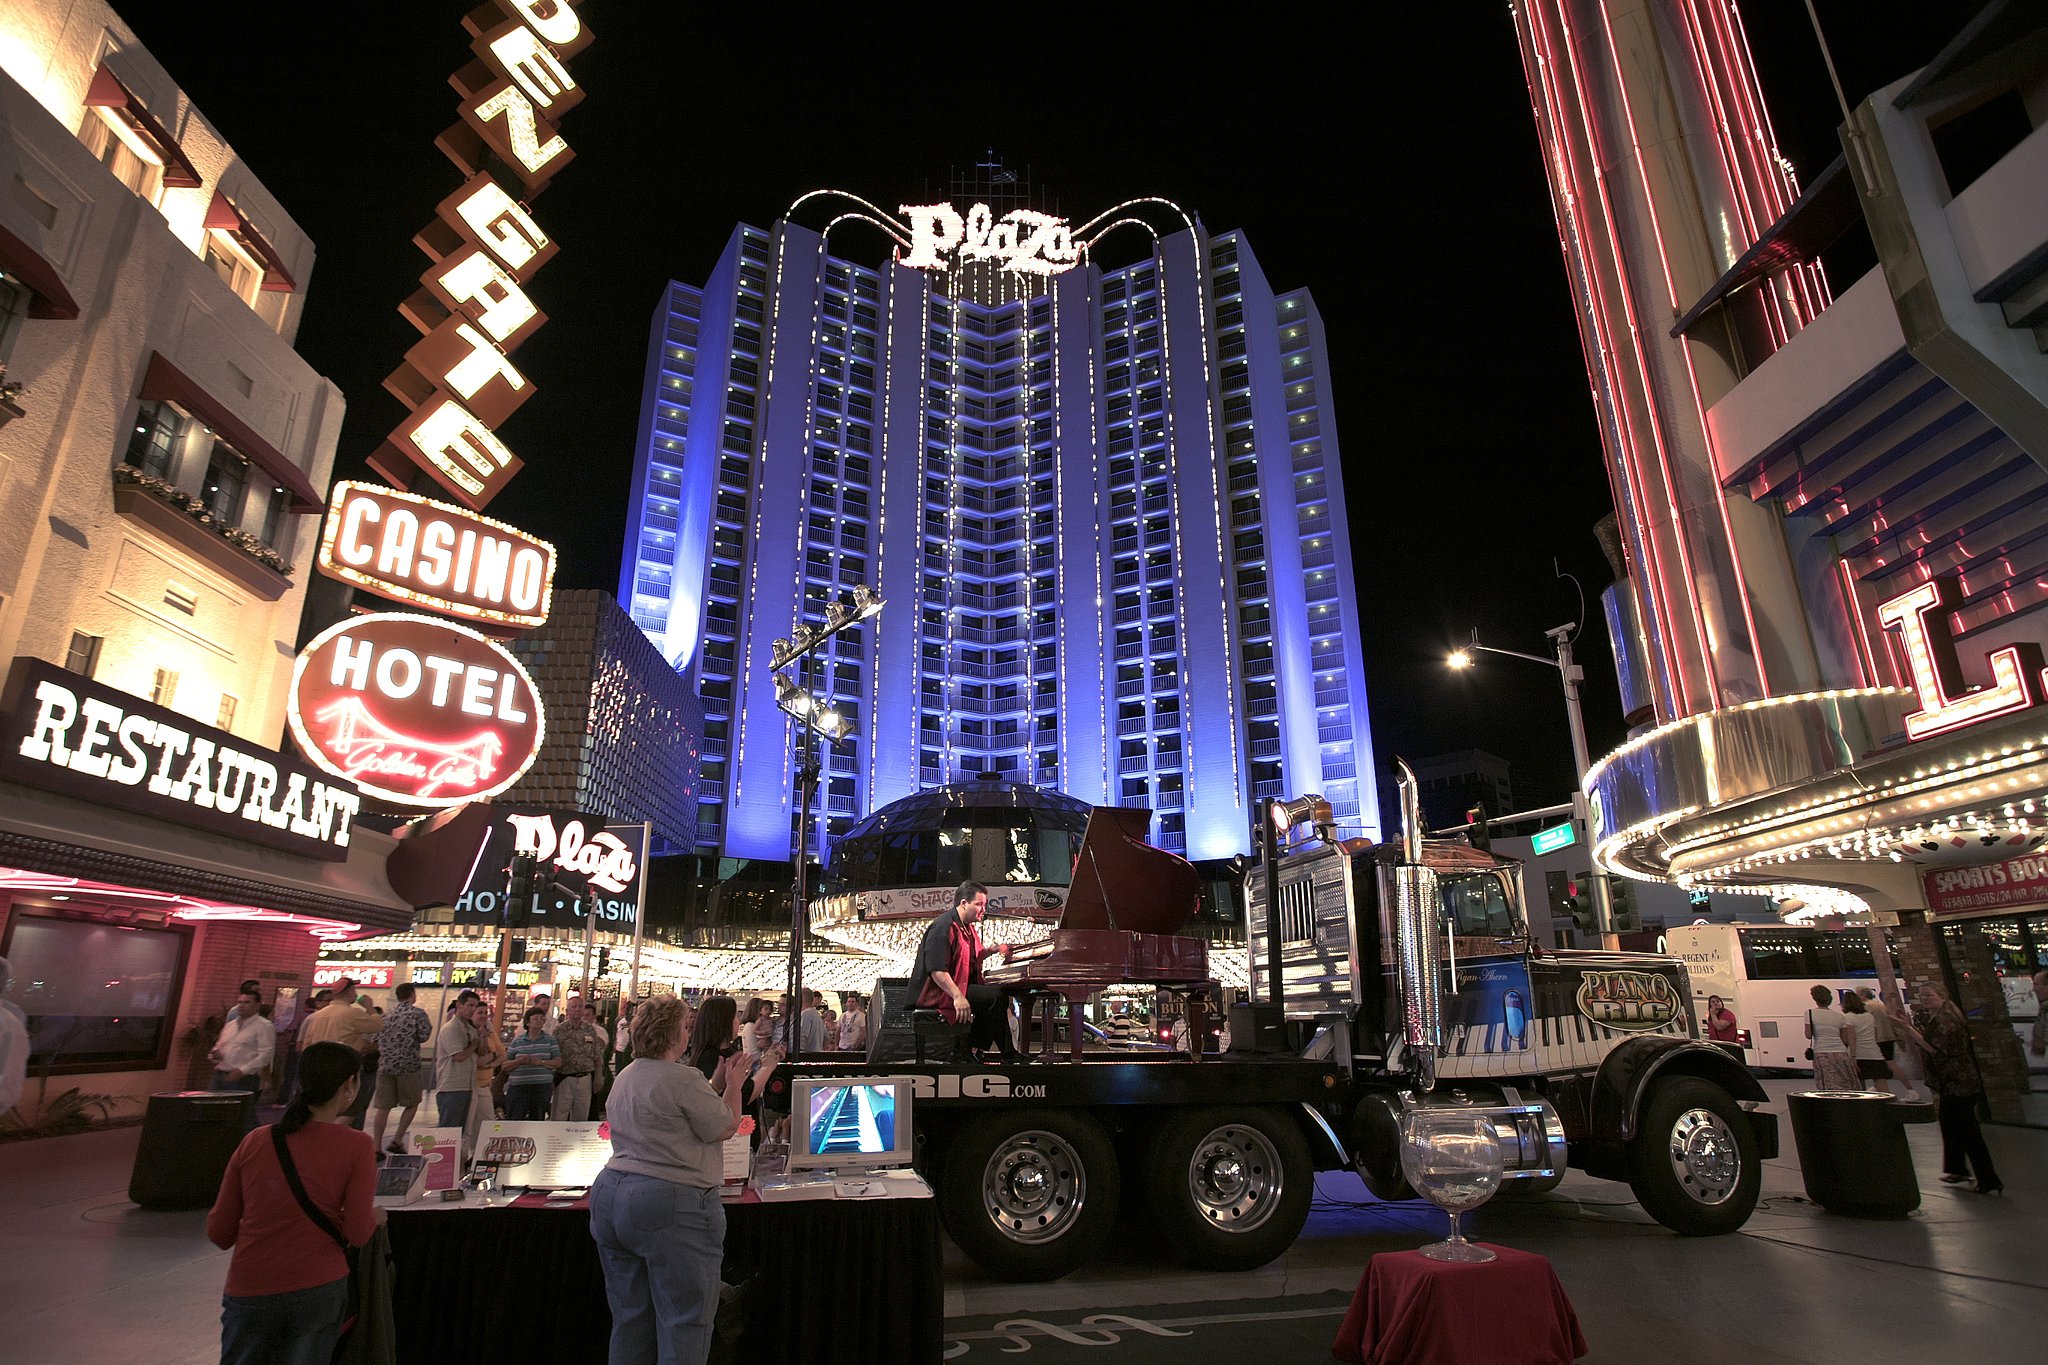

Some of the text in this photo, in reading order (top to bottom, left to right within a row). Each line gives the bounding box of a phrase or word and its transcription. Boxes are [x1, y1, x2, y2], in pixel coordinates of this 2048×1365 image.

[898, 202, 1080, 277] Plaza
[409, 182, 549, 496] GATE
[339, 496, 544, 611] CASINO
[330, 635, 527, 724] HOTEL
[1877, 579, 2048, 744] L
[19, 680, 361, 848] RESTAURANT
[345, 741, 478, 798] Golden Gate
[454, 890, 639, 923] HOL CASIN
[1935, 863, 2007, 893] SPORTS
[1583, 972, 1669, 1000] PIANO
[1682, 953, 1709, 963] REGENT
[1592, 1001, 1672, 1022] RIG
[488, 1136, 534, 1151] PIANO
